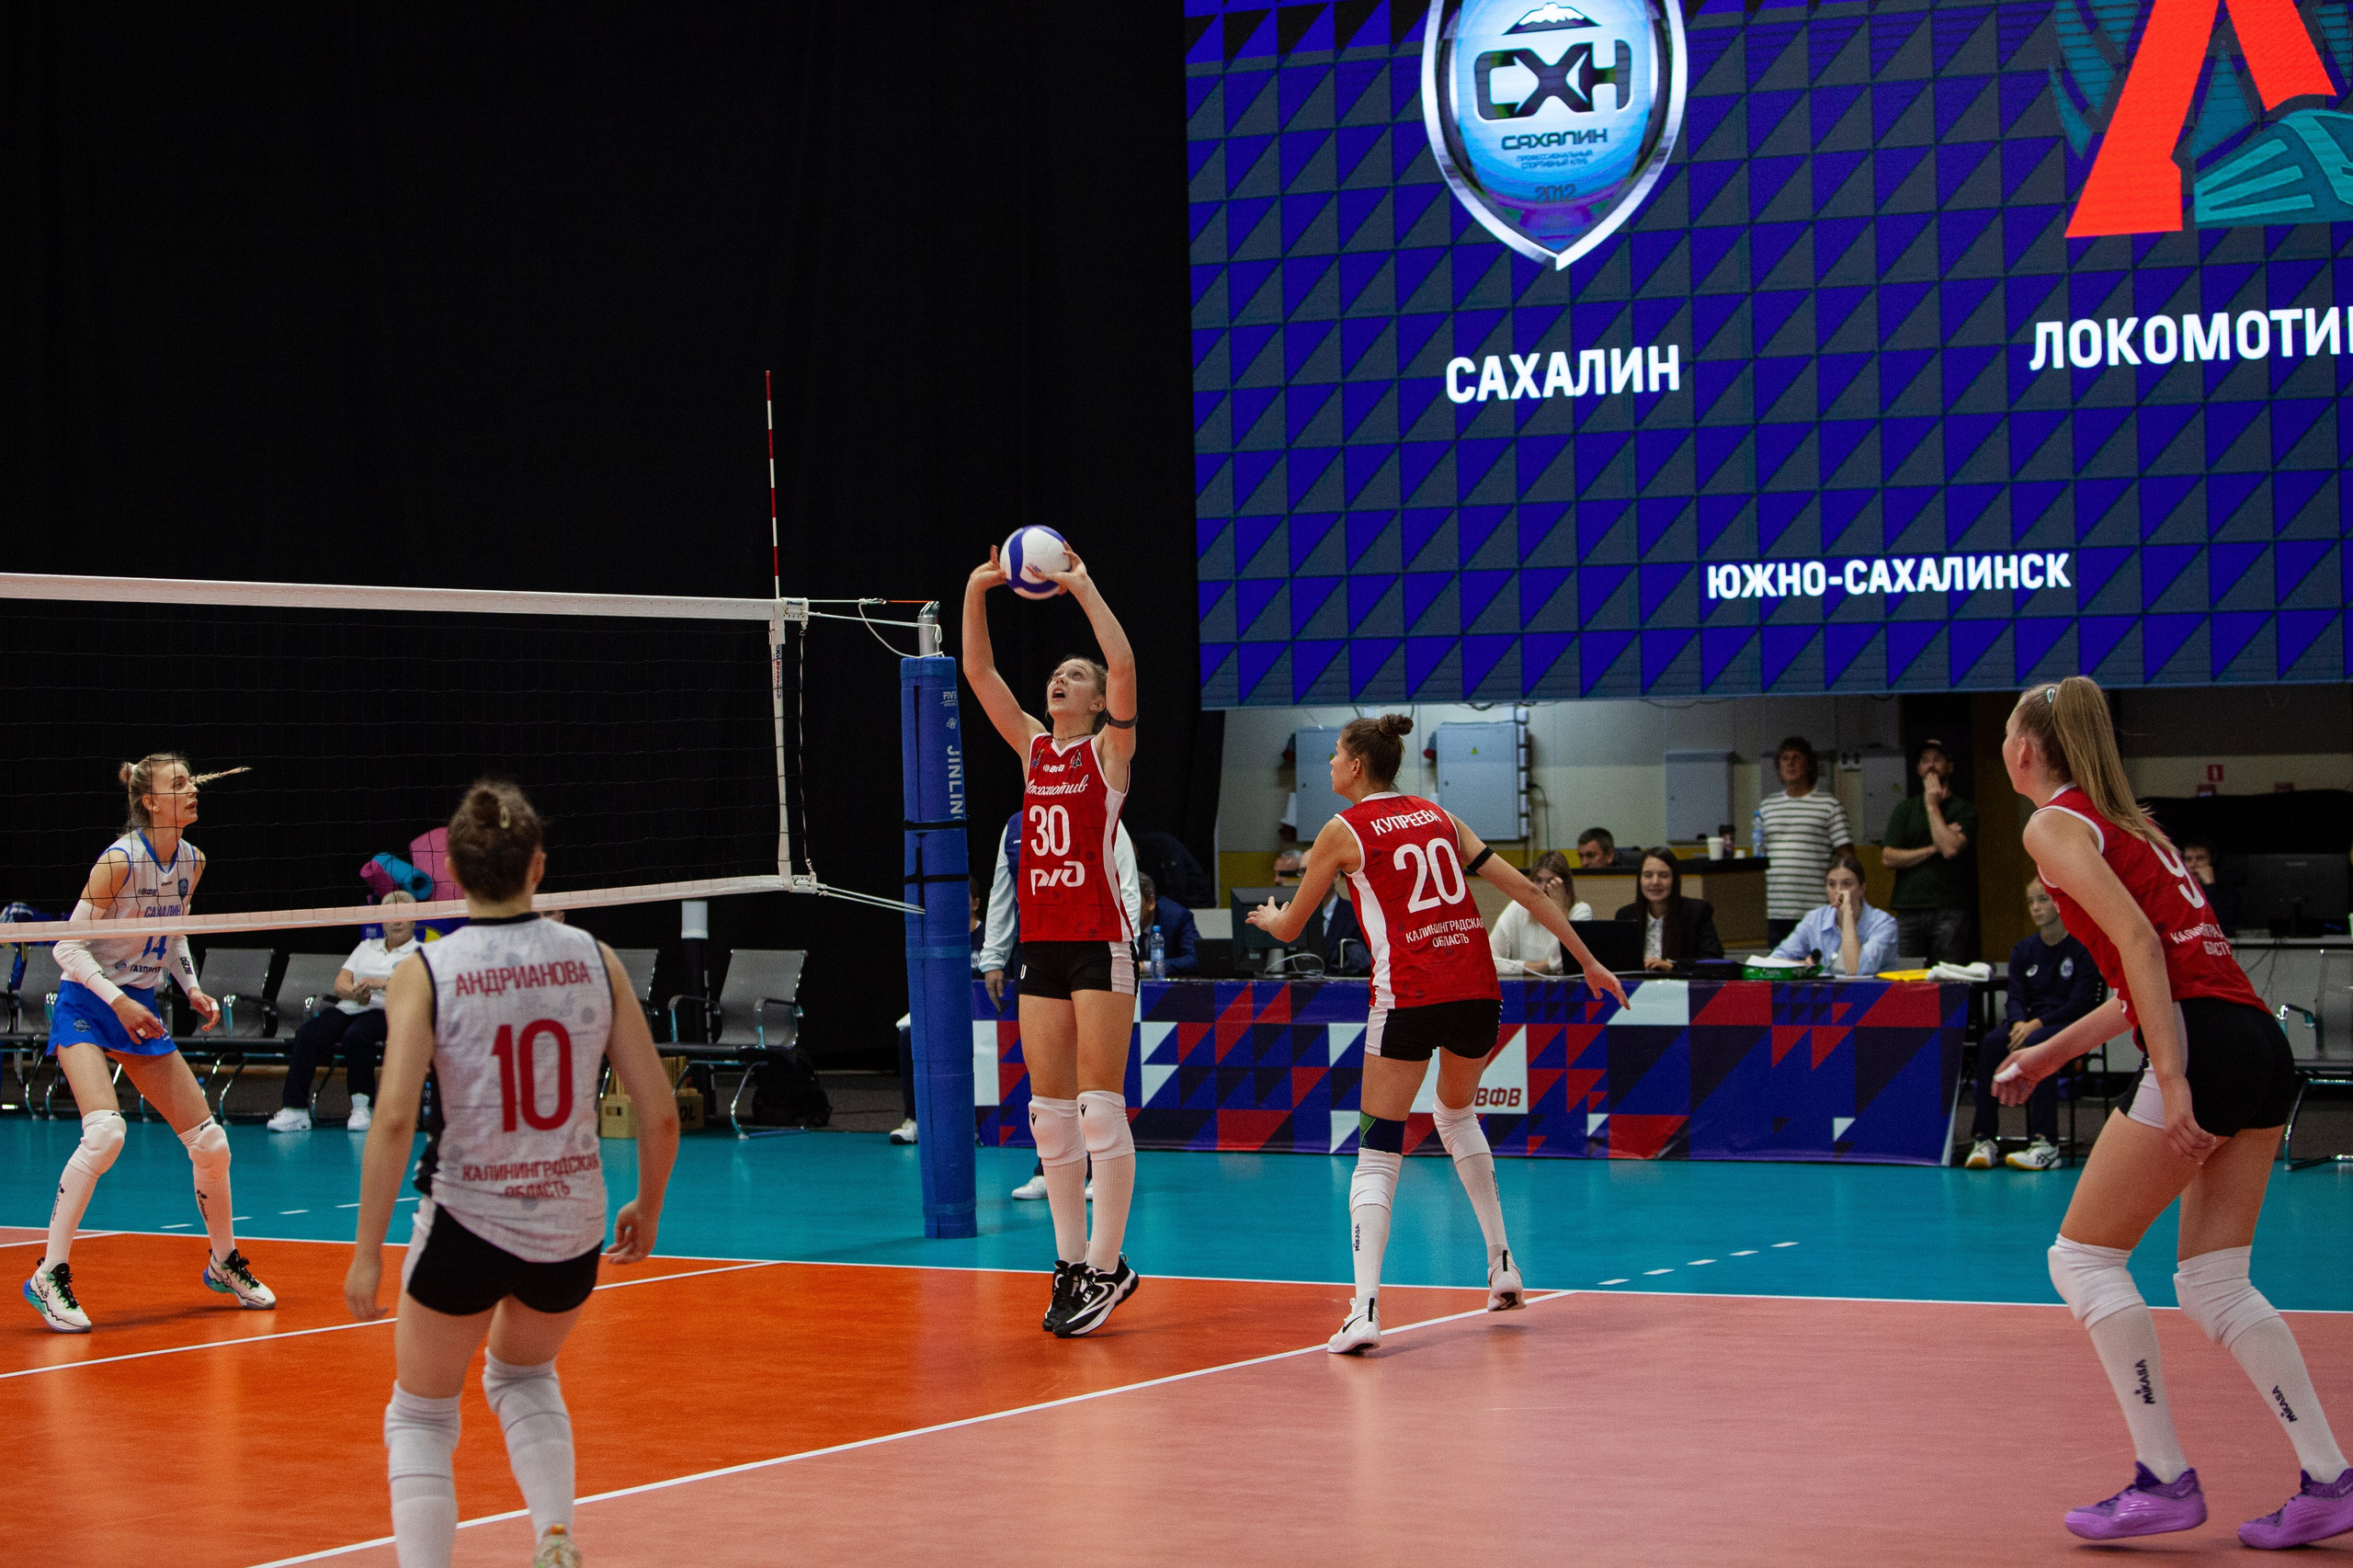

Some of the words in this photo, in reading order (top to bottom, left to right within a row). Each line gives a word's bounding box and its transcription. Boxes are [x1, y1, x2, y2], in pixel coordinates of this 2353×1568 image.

[1501, 128, 1608, 150] САХАЛИН
[1534, 183, 1576, 203] 2012
[2029, 305, 2353, 371] ЛОКОМОТИ
[1446, 344, 1680, 403] САХАЛИН
[1708, 552, 2071, 600] ЮЖНО-САХАЛИНСК
[947, 744, 964, 820] JINLIN
[1029, 804, 1071, 857] 30
[1370, 809, 1442, 836] КУПРЕЕВА
[1393, 837, 1466, 914] 20
[2147, 838, 2205, 909] 9
[143, 904, 182, 918] САХАЛИН
[1432, 933, 1470, 948] ОБЛАСТЬ
[455, 960, 592, 997] АНДРИАНОВА
[491, 1018, 574, 1132] 10
[1474, 1087, 1522, 1108] ВФВ
